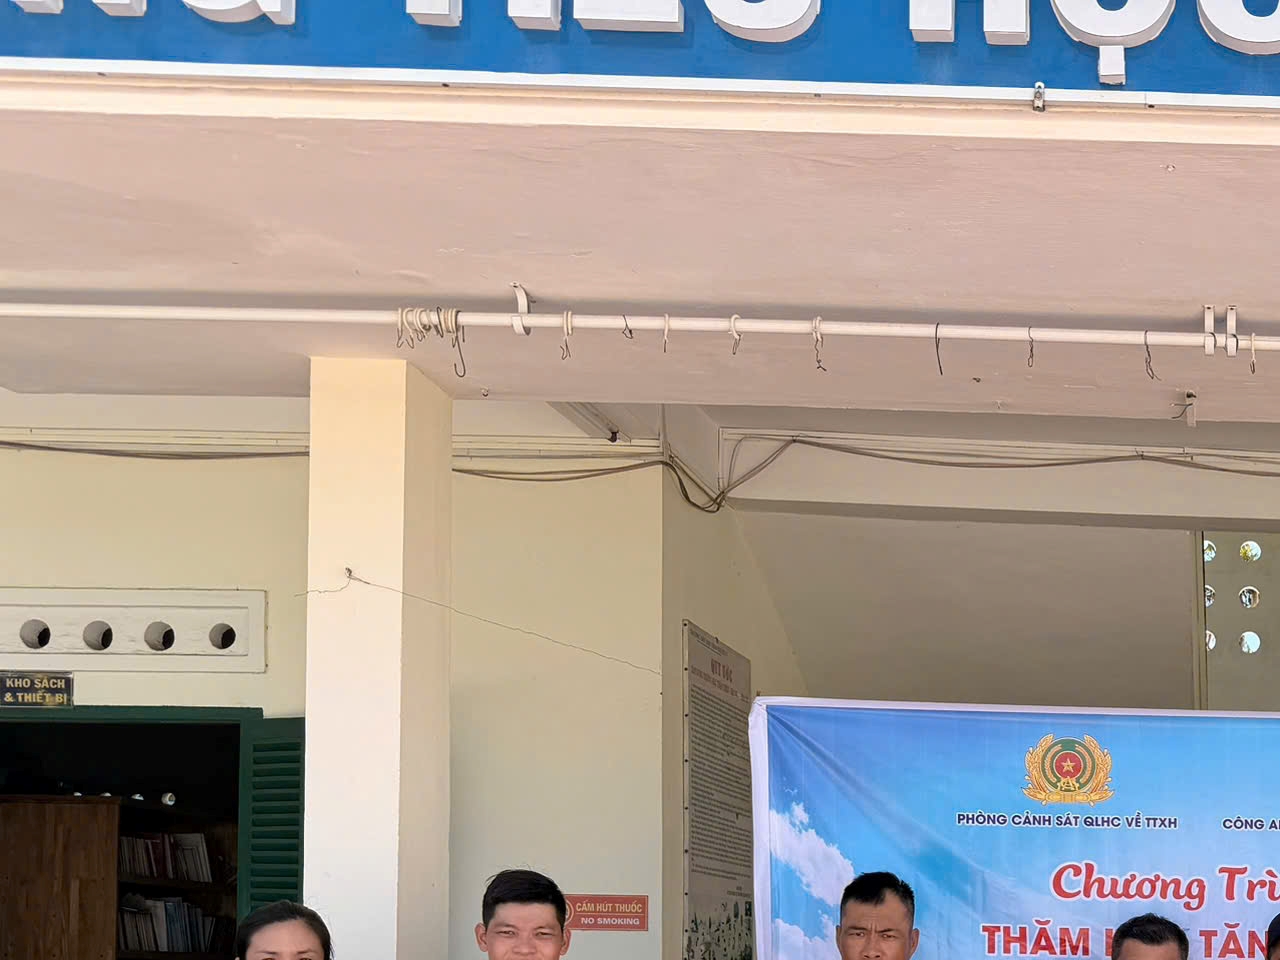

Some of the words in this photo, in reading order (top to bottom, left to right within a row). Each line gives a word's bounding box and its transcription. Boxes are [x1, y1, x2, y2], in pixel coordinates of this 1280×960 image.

[5, 678, 31, 689] KHO
[34, 675, 66, 690] SÁCH
[4, 692, 13, 703] &
[16, 688, 51, 704] THIẾT
[957, 811, 1007, 826] PHÒNG
[1011, 811, 1052, 826] CẢNH
[1055, 812, 1079, 827] SÁT
[1083, 816, 1121, 828] QLHC
[1125, 811, 1142, 828] VỀ
[1145, 817, 1178, 829] TTXH
[1222, 815, 1265, 830] CÔNG
[1052, 861, 1206, 911] Chương
[576, 899, 595, 912] CẤM
[596, 901, 613, 912] HÚT
[614, 900, 643, 913] THUỐC
[581, 917, 595, 925] NO
[597, 917, 640, 925] SMOKING
[981, 919, 1090, 956] THĂM
